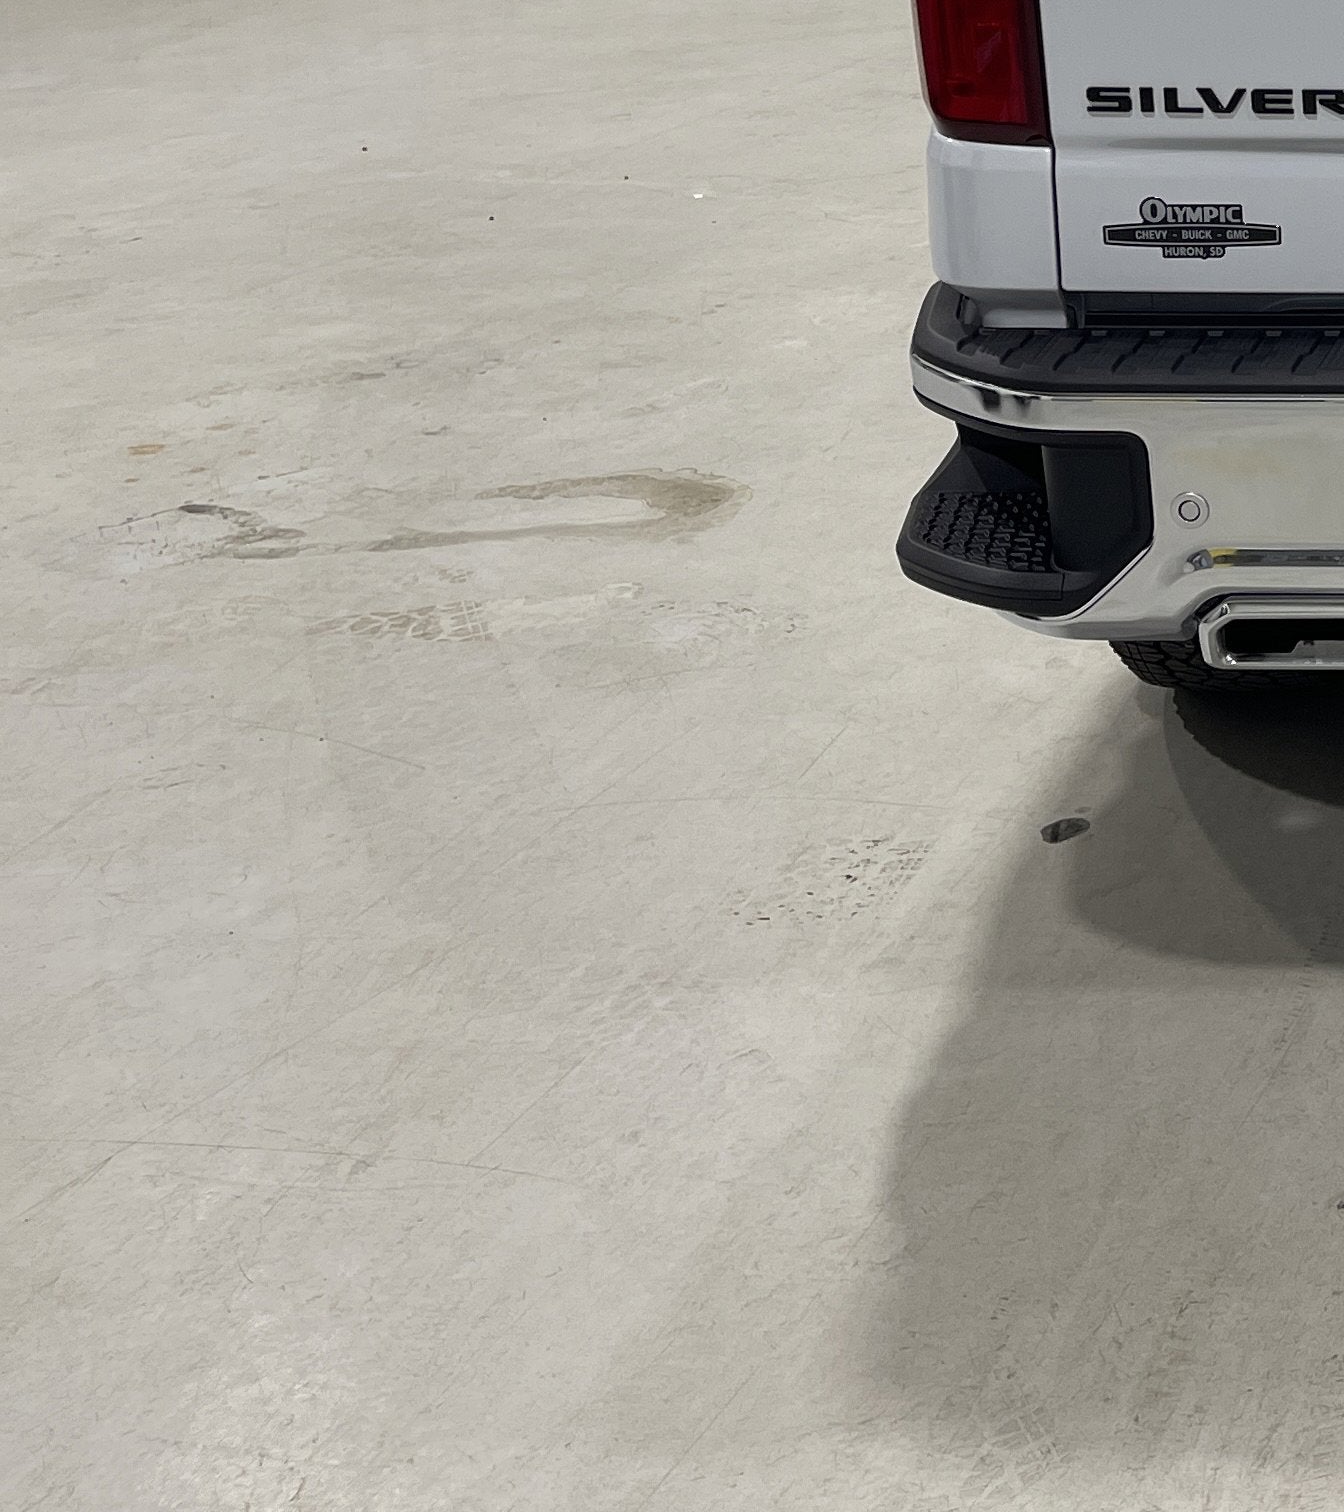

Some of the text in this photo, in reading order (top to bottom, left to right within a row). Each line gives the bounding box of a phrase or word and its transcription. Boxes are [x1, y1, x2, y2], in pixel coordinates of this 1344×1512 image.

[1135, 229, 1167, 240] CHEVY
[1182, 229, 1212, 240] BUICK
[1226, 229, 1249, 240] GMC
[1164, 247, 1224, 258] HURON, SD
